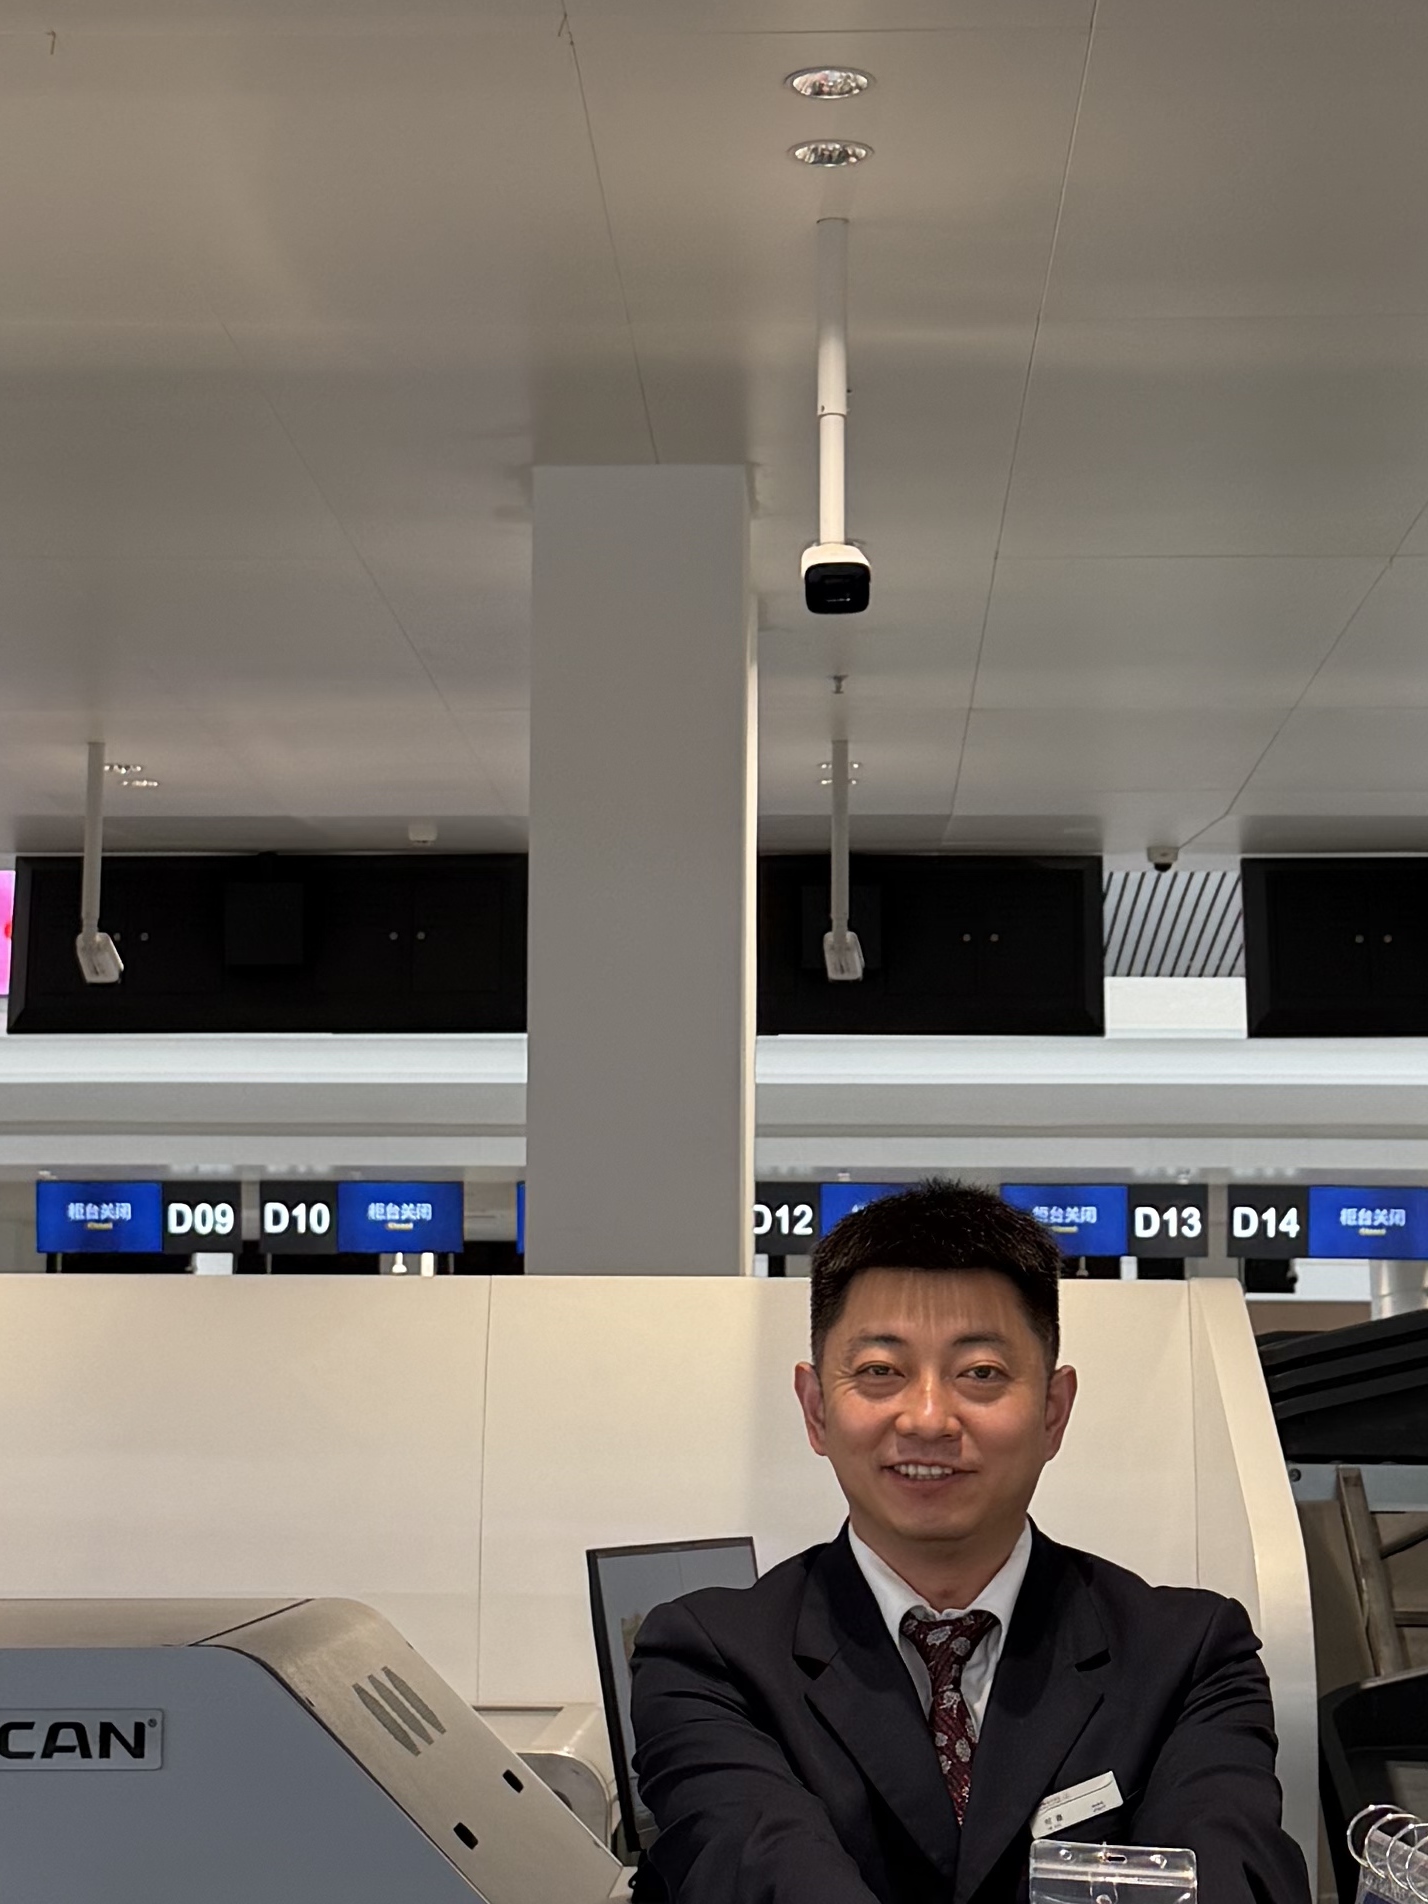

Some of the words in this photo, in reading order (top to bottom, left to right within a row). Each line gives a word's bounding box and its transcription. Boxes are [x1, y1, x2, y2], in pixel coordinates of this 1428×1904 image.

[167, 1201, 235, 1236] D09
[263, 1201, 331, 1236] D10
[1134, 1205, 1202, 1239] D13
[1232, 1206, 1300, 1240] D14
